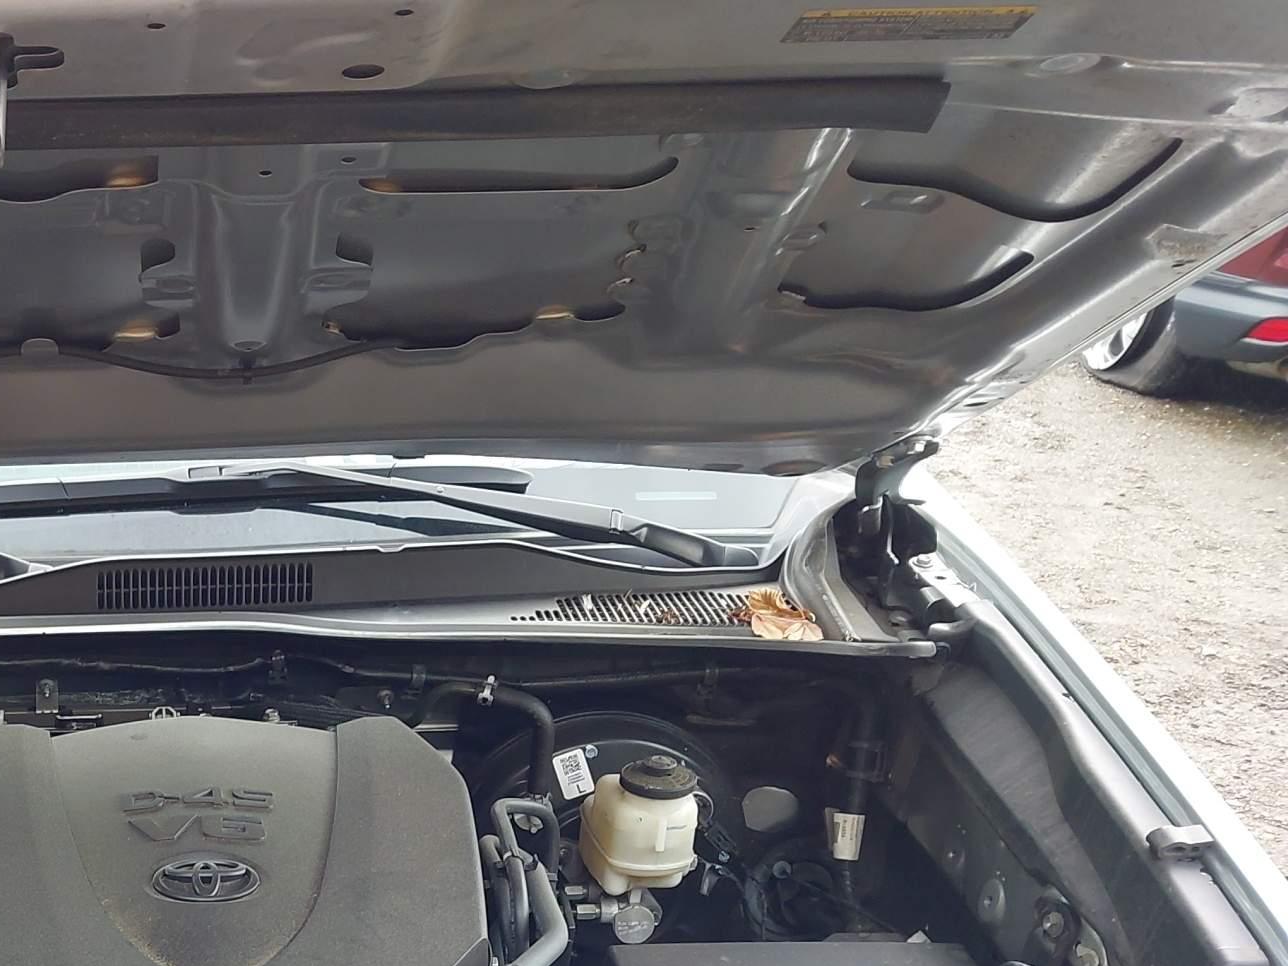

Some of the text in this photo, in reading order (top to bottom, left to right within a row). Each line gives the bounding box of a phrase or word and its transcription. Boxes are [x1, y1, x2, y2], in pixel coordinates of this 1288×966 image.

[121, 786, 275, 813] D-4S
[576, 784, 587, 794] L
[128, 814, 267, 842] V6
